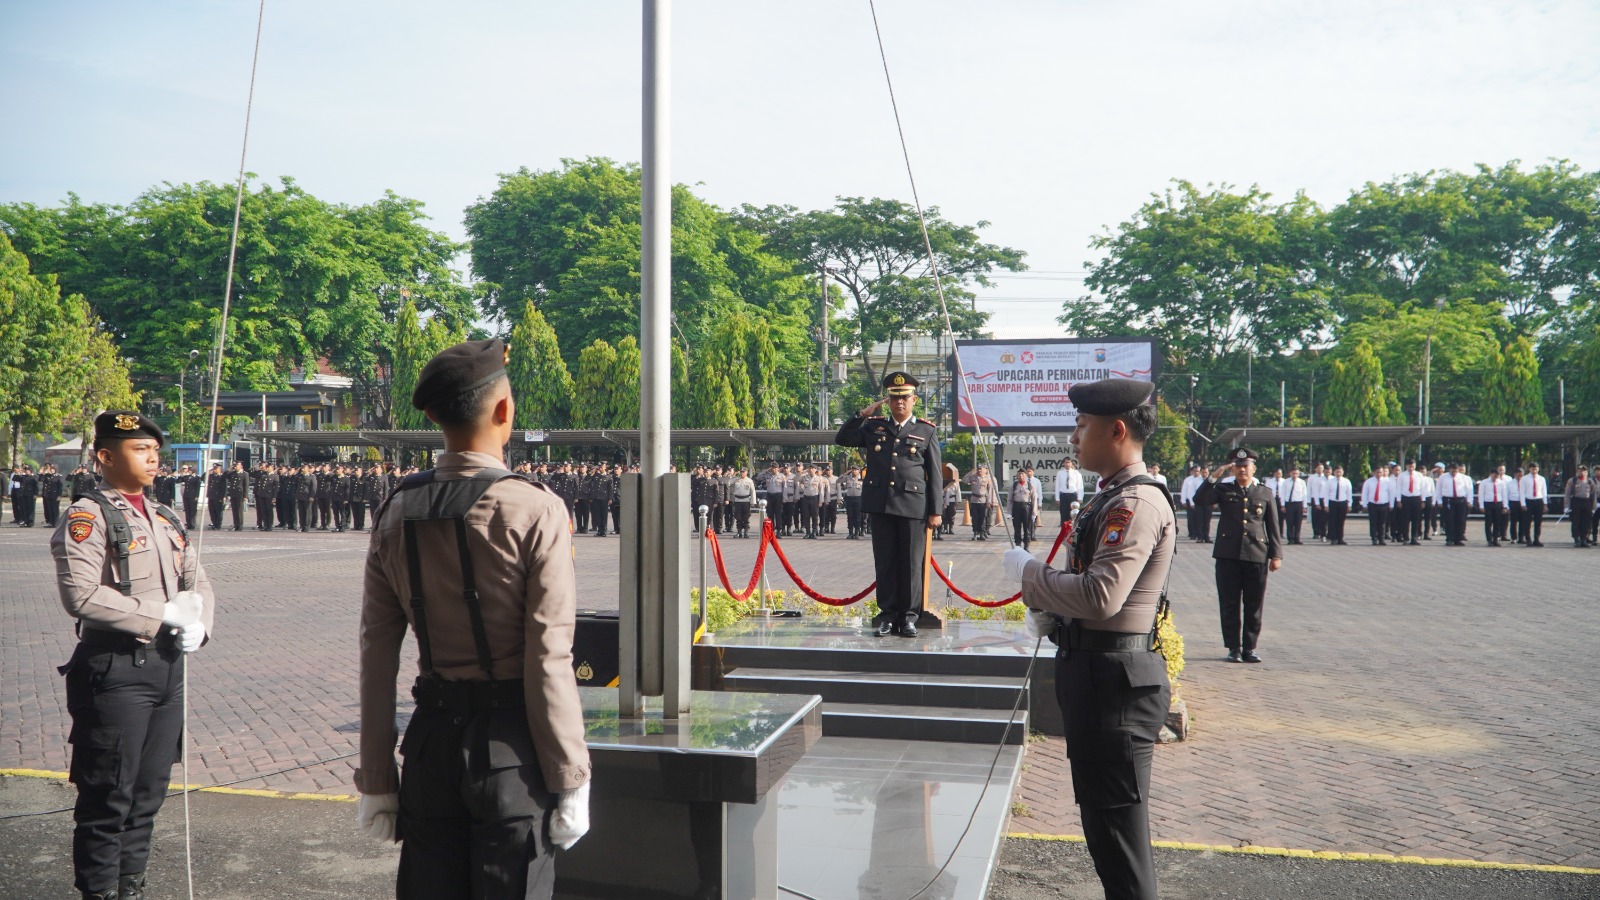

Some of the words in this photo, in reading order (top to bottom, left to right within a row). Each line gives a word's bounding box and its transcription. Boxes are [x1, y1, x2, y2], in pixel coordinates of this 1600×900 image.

[997, 370, 1044, 381] UPACARA
[1047, 368, 1110, 381] PERINGATAN
[968, 384, 984, 393] HARI
[987, 384, 1021, 393] SUMPAH
[1025, 383, 1060, 392] PEMUDA
[971, 435, 1057, 445] WICAKSANA
[1019, 446, 1070, 454] LAPANGAN
